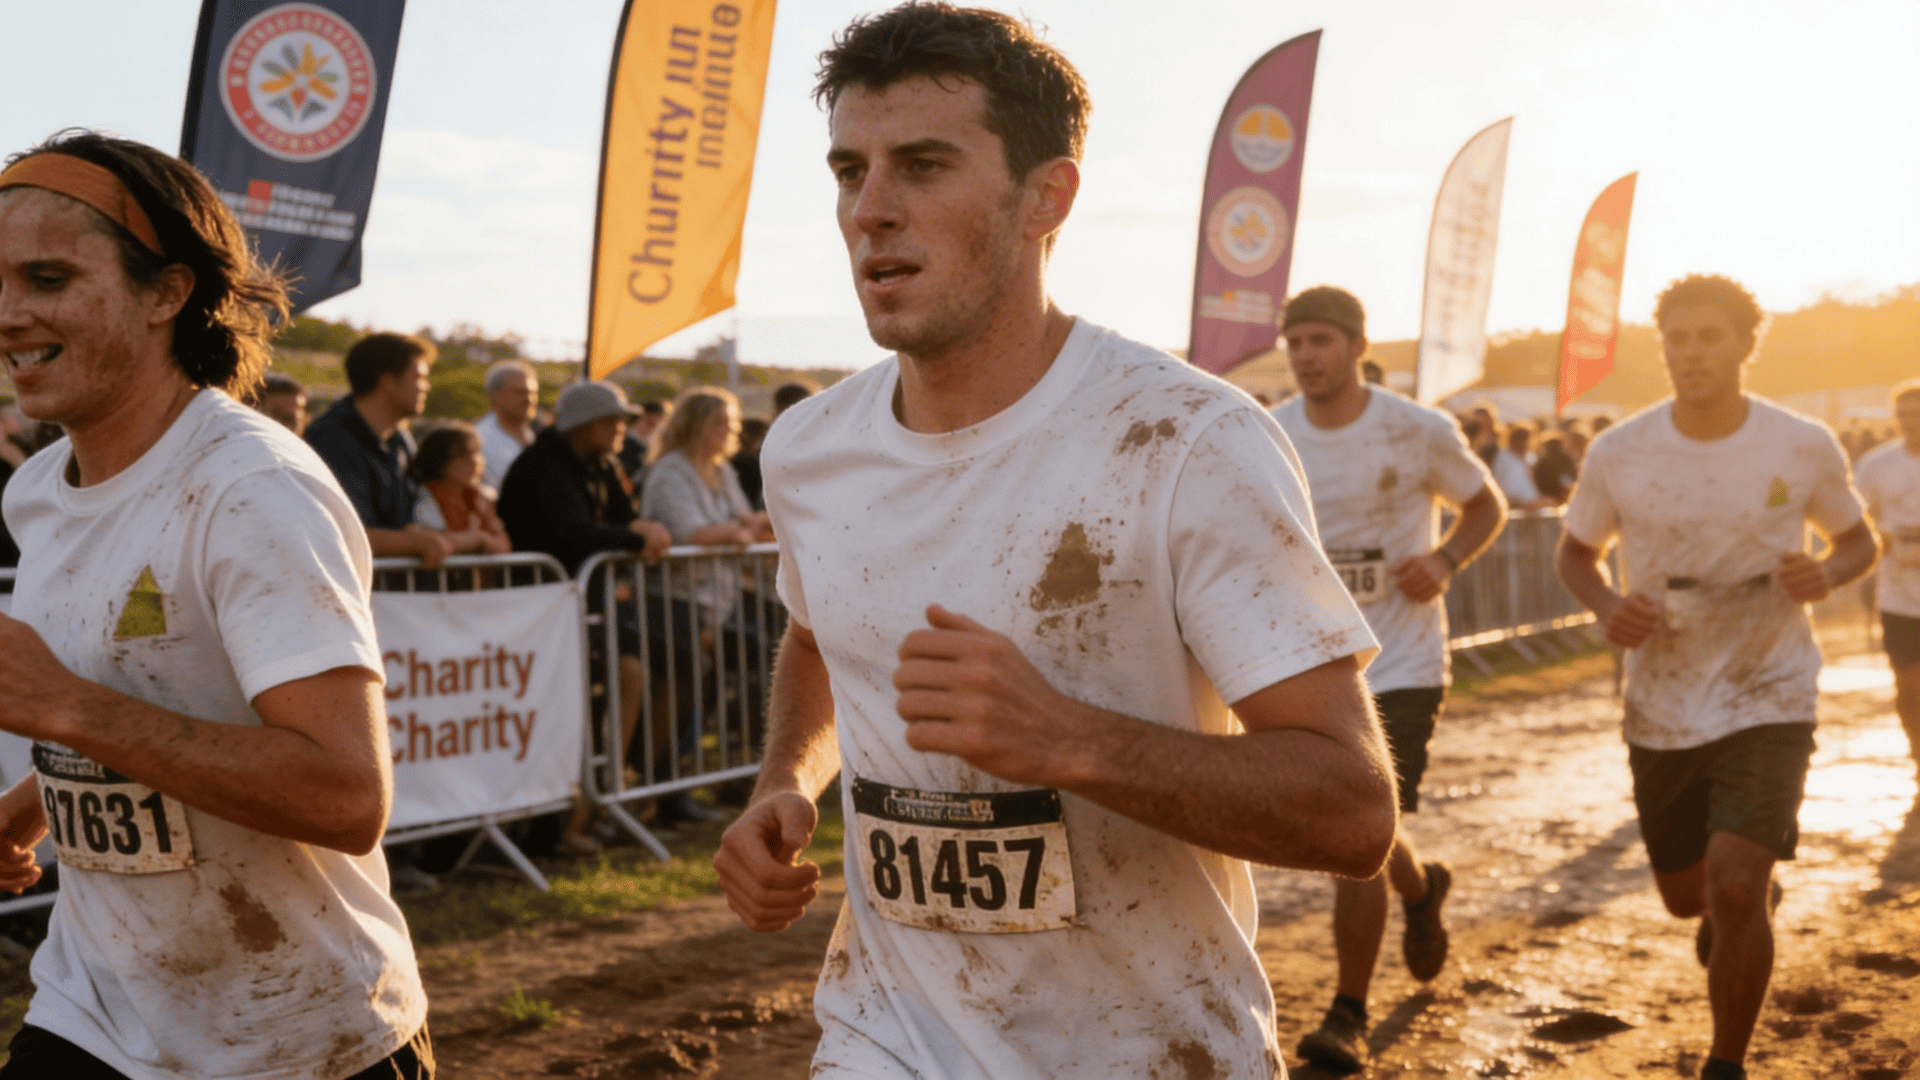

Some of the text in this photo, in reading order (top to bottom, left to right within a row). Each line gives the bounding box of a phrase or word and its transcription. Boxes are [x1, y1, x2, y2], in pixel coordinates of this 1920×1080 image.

[382, 642, 536, 699] Charity
[44, 785, 172, 855] 97631
[869, 829, 1046, 911] 81457
